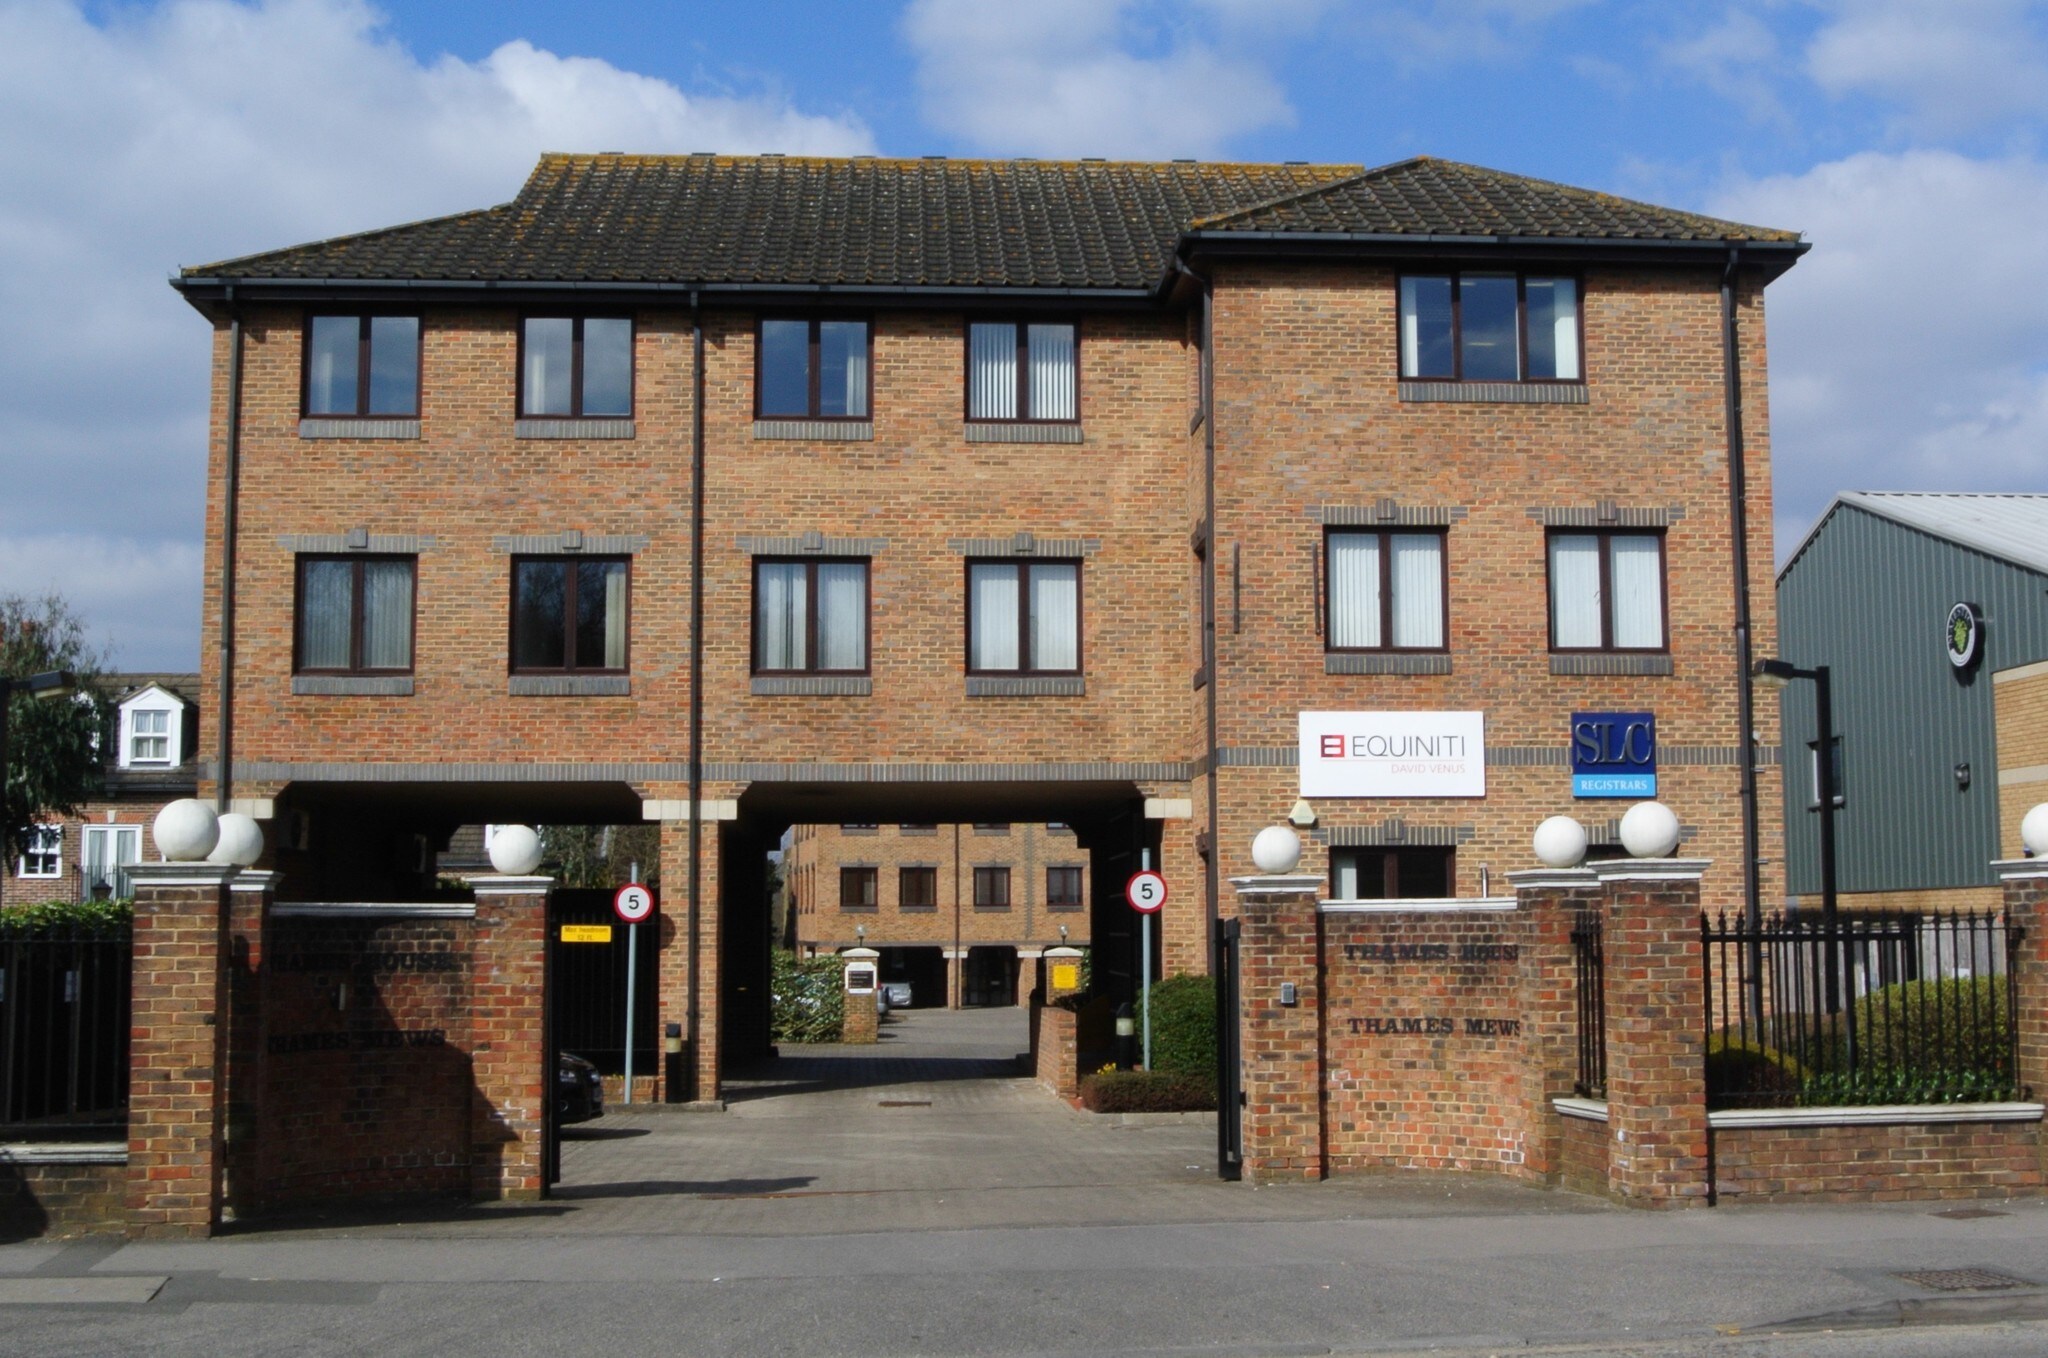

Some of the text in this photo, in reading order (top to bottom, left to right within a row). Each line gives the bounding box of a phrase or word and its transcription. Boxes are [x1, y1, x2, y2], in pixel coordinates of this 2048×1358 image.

[1352, 734, 1465, 758] EQUINITI
[1575, 721, 1652, 764] SLC
[1391, 763, 1466, 774] DAVID VENUS
[1581, 780, 1648, 791] REGISTRARS
[1141, 883, 1153, 900] 5
[628, 894, 640, 910] 5
[1344, 944, 1449, 961] THAMES
[1347, 1017, 1455, 1034] THAMES
